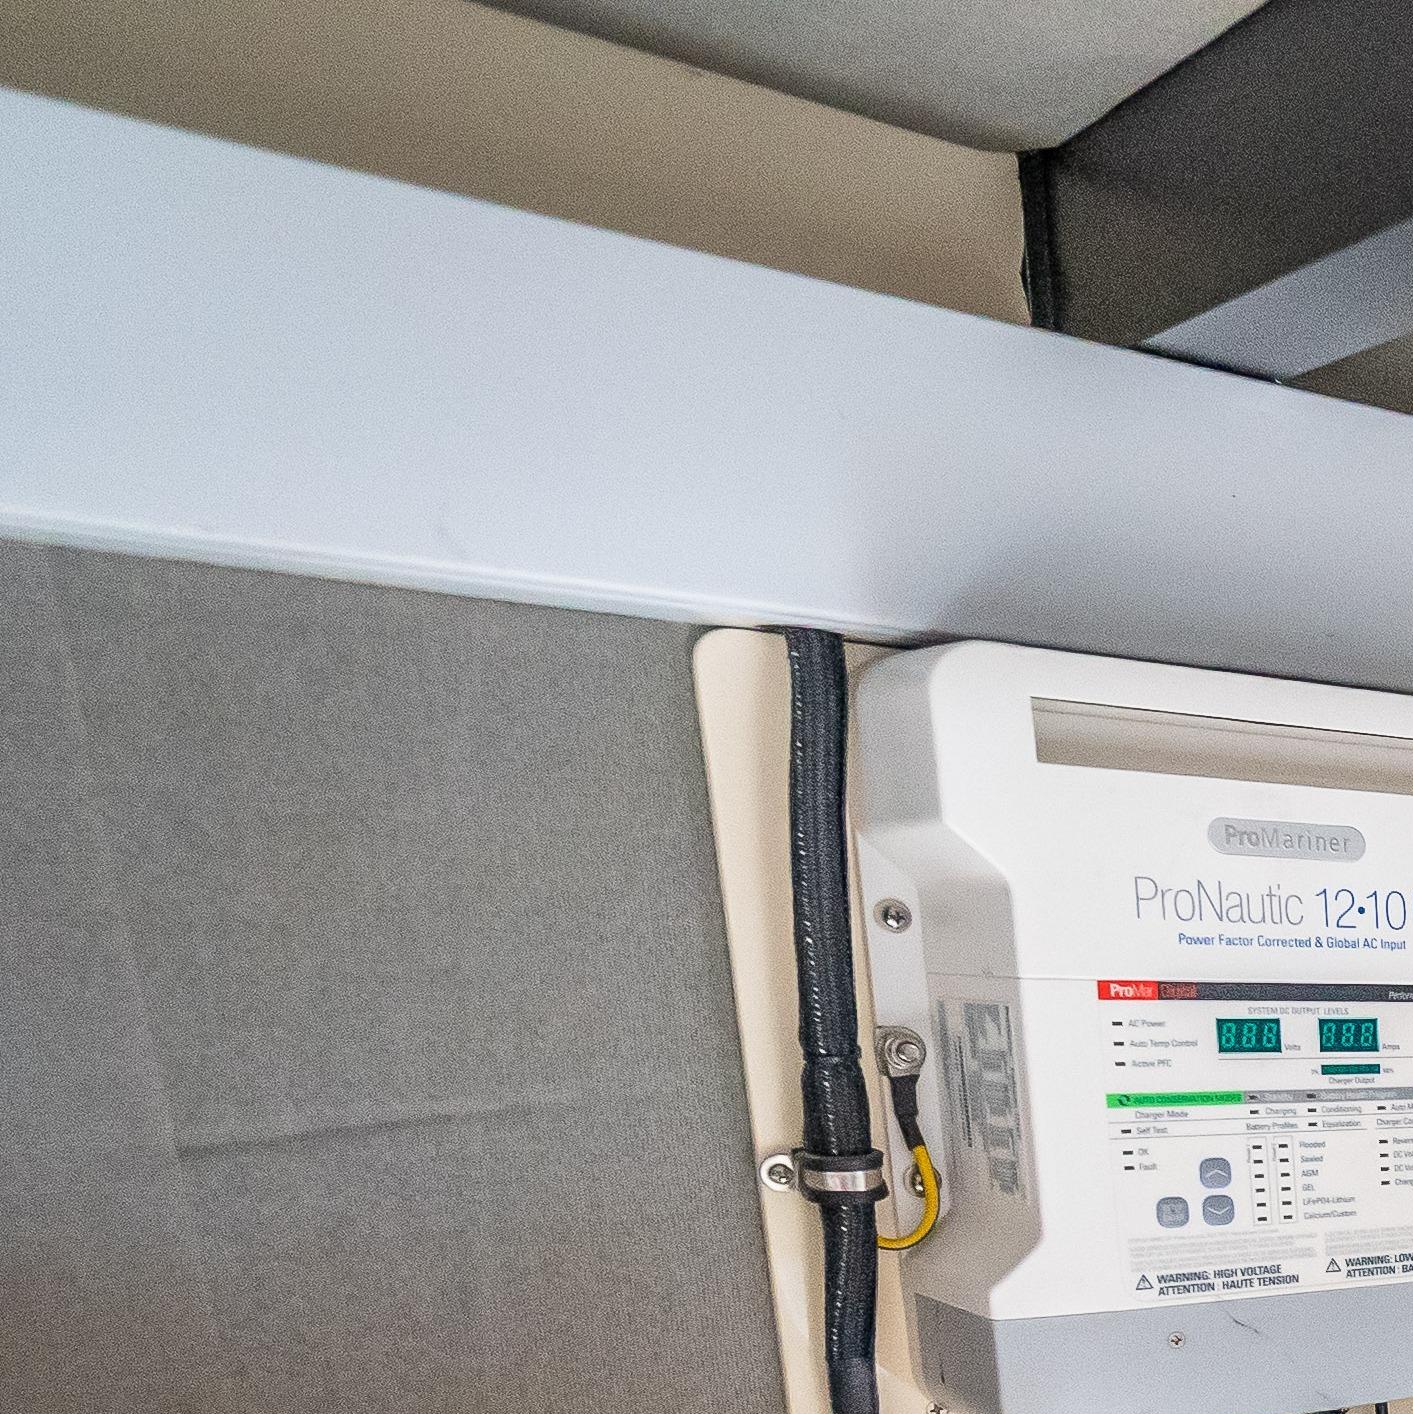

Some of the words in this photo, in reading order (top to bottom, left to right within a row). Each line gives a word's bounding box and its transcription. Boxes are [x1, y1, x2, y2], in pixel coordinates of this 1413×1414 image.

[1225, 824, 1351, 854] ProMariner
[1134, 876, 1304, 925] ProNautic
[1179, 933, 1215, 947] Power
[1218, 934, 1254, 947] Factor
[1257, 935, 1311, 948] Corrected
[1314, 936, 1323, 949] &
[1326, 936, 1360, 949] Global
[1361, 937, 1378, 950] AC
[1381, 938, 1407, 952] Input
[1345, 1255, 1392, 1267] WARNING:
[1157, 1270, 1210, 1284] WARNING:
[1213, 1268, 1238, 1279] HIGH
[1240, 1264, 1282, 1277] VOLTAGE
[1222, 1278, 1254, 1290] HAUTE
[1257, 1274, 1299, 1287] TENSION
